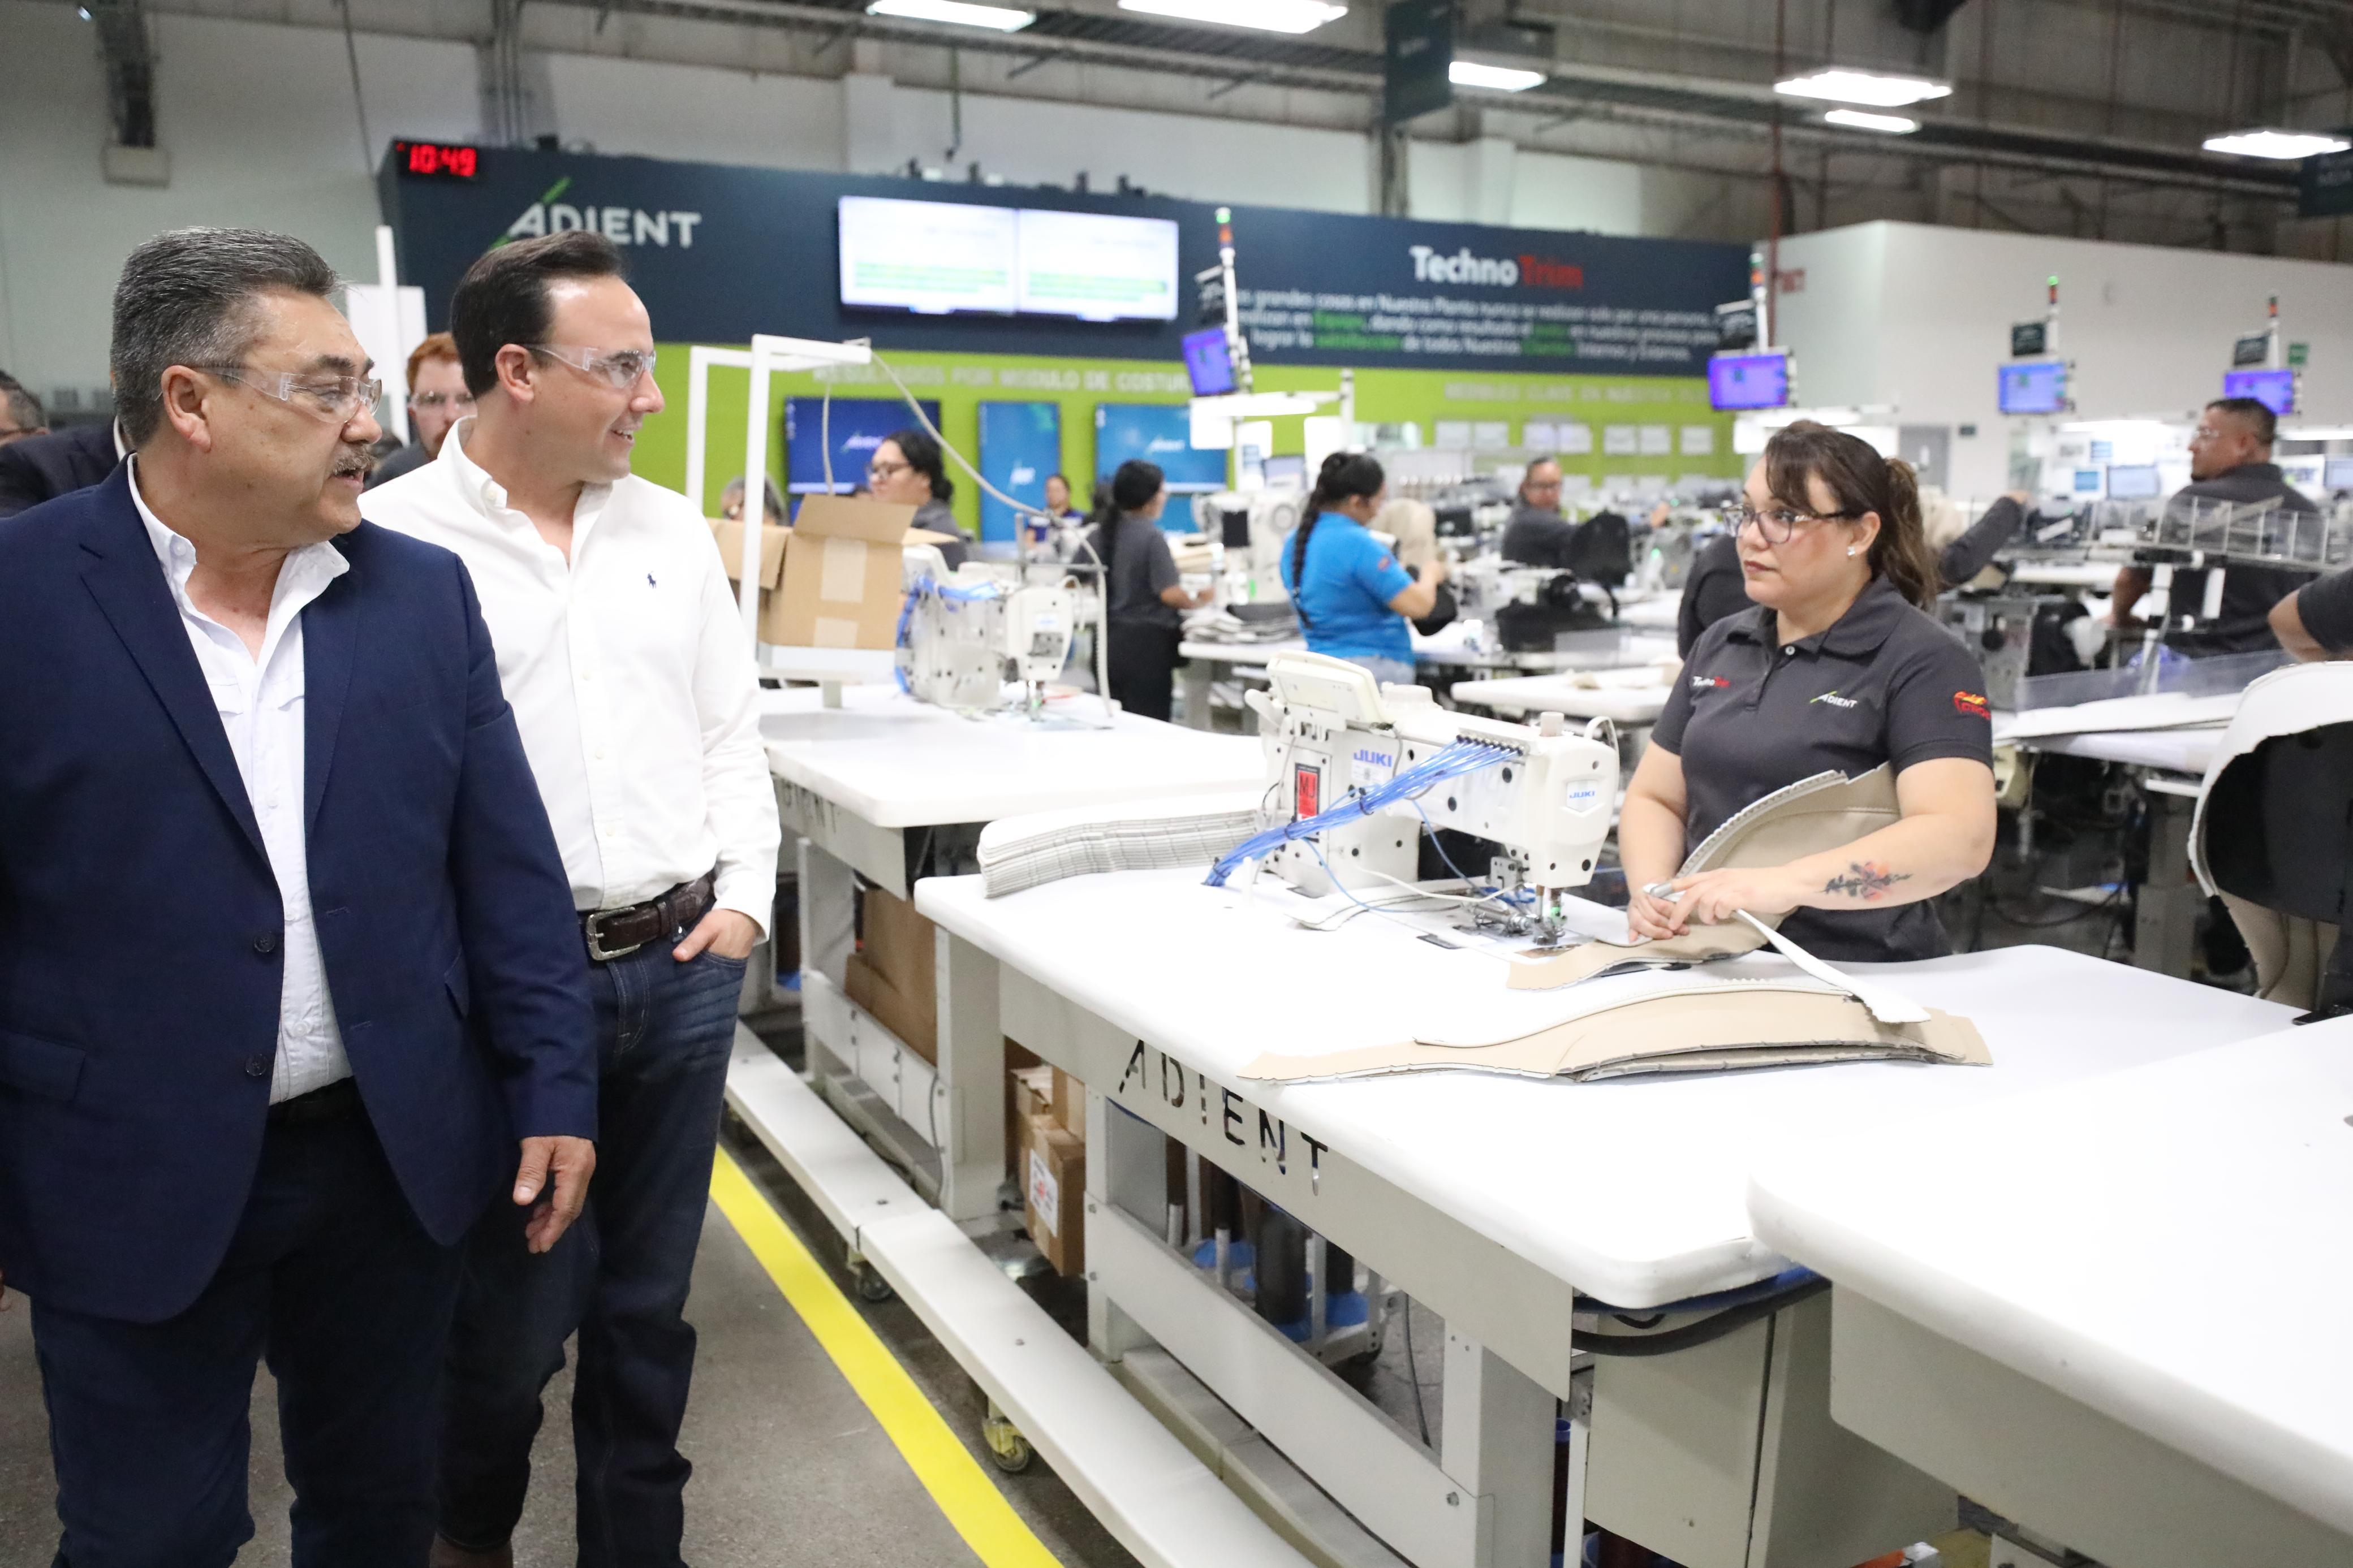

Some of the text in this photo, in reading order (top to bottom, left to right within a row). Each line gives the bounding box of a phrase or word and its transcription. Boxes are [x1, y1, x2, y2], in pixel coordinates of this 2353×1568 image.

[409, 144, 477, 177] 10:49
[505, 200, 702, 248] ADIENT
[1814, 692, 1858, 708] ADIENT
[1354, 749, 1393, 768] JUKI
[1119, 1039, 1329, 1197] ADIENT
